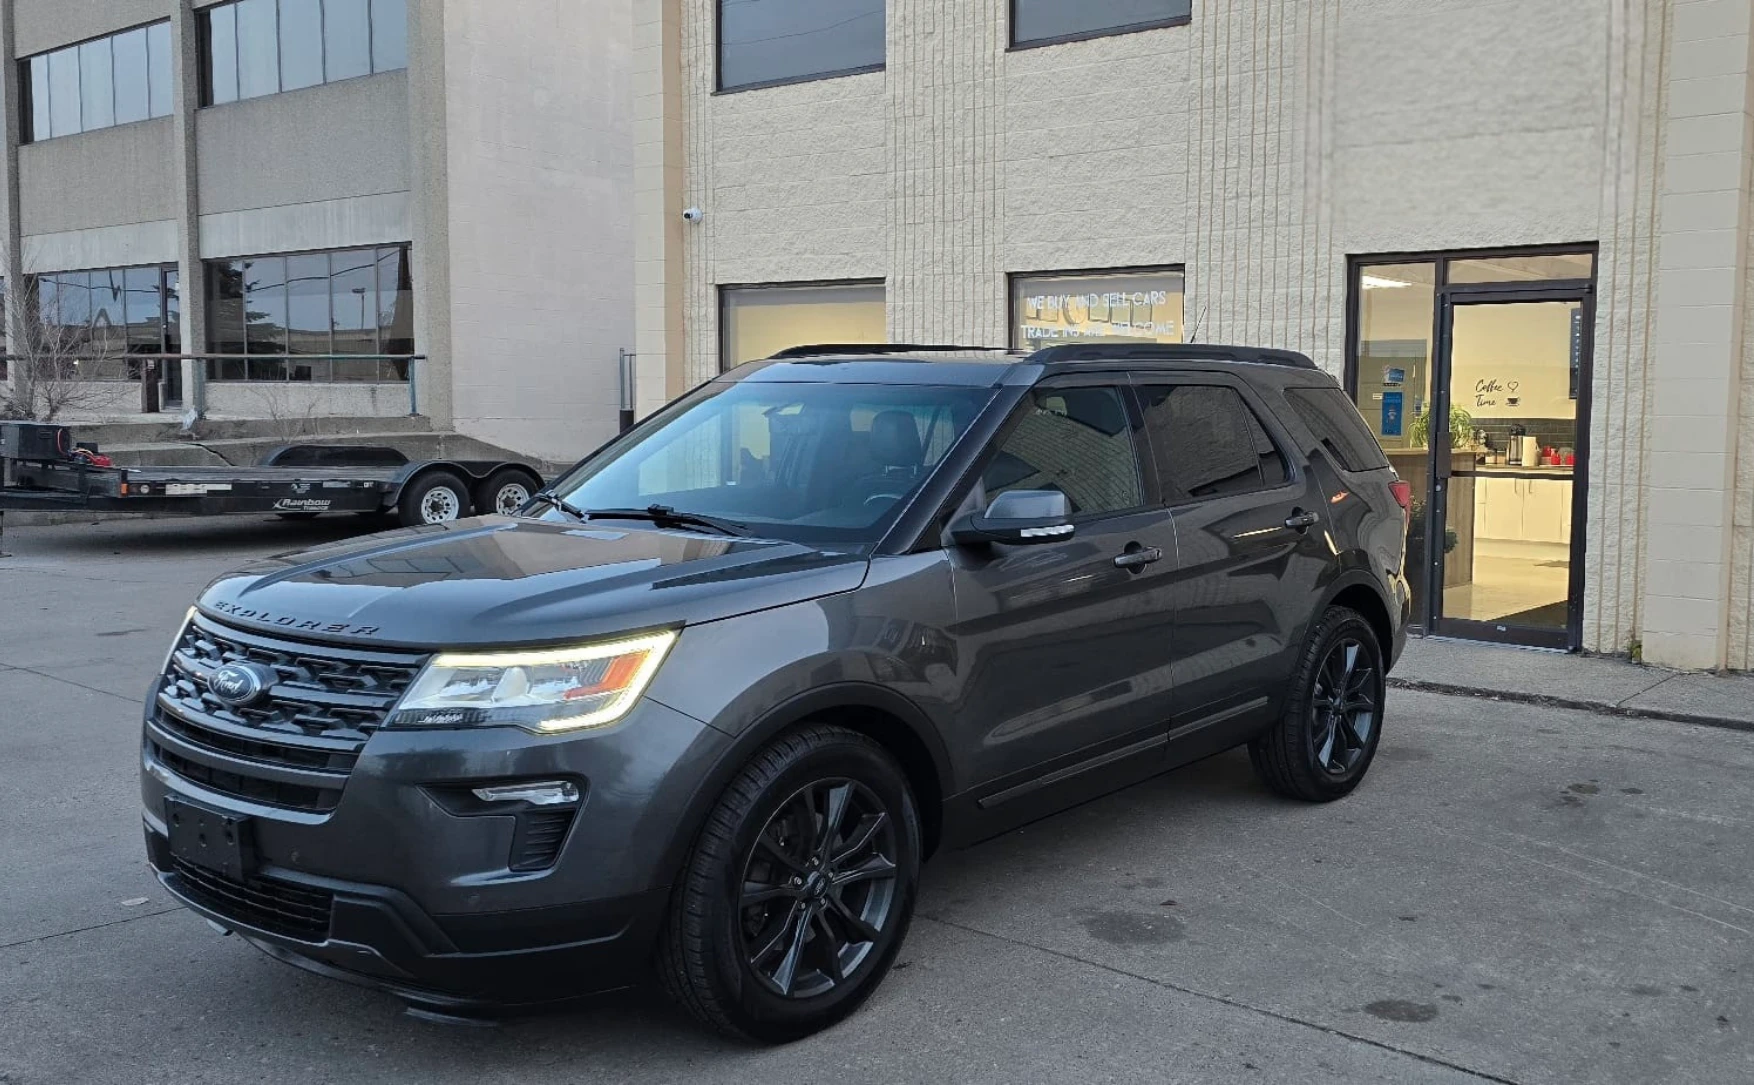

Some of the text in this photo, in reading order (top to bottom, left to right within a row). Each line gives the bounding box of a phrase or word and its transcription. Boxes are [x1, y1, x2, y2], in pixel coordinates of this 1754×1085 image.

[1026, 296, 1045, 310] WE
[1047, 294, 1070, 310] BUY
[1103, 292, 1129, 307] SELL
[1132, 290, 1166, 306] CARS
[1020, 324, 1059, 339] TRADE
[1475, 379, 1504, 393] Coffee
[1474, 394, 1496, 407] Time
[282, 498, 331, 506] Rainbow
[215, 600, 380, 636] EXPLORER
[214, 670, 244, 694] Ford
